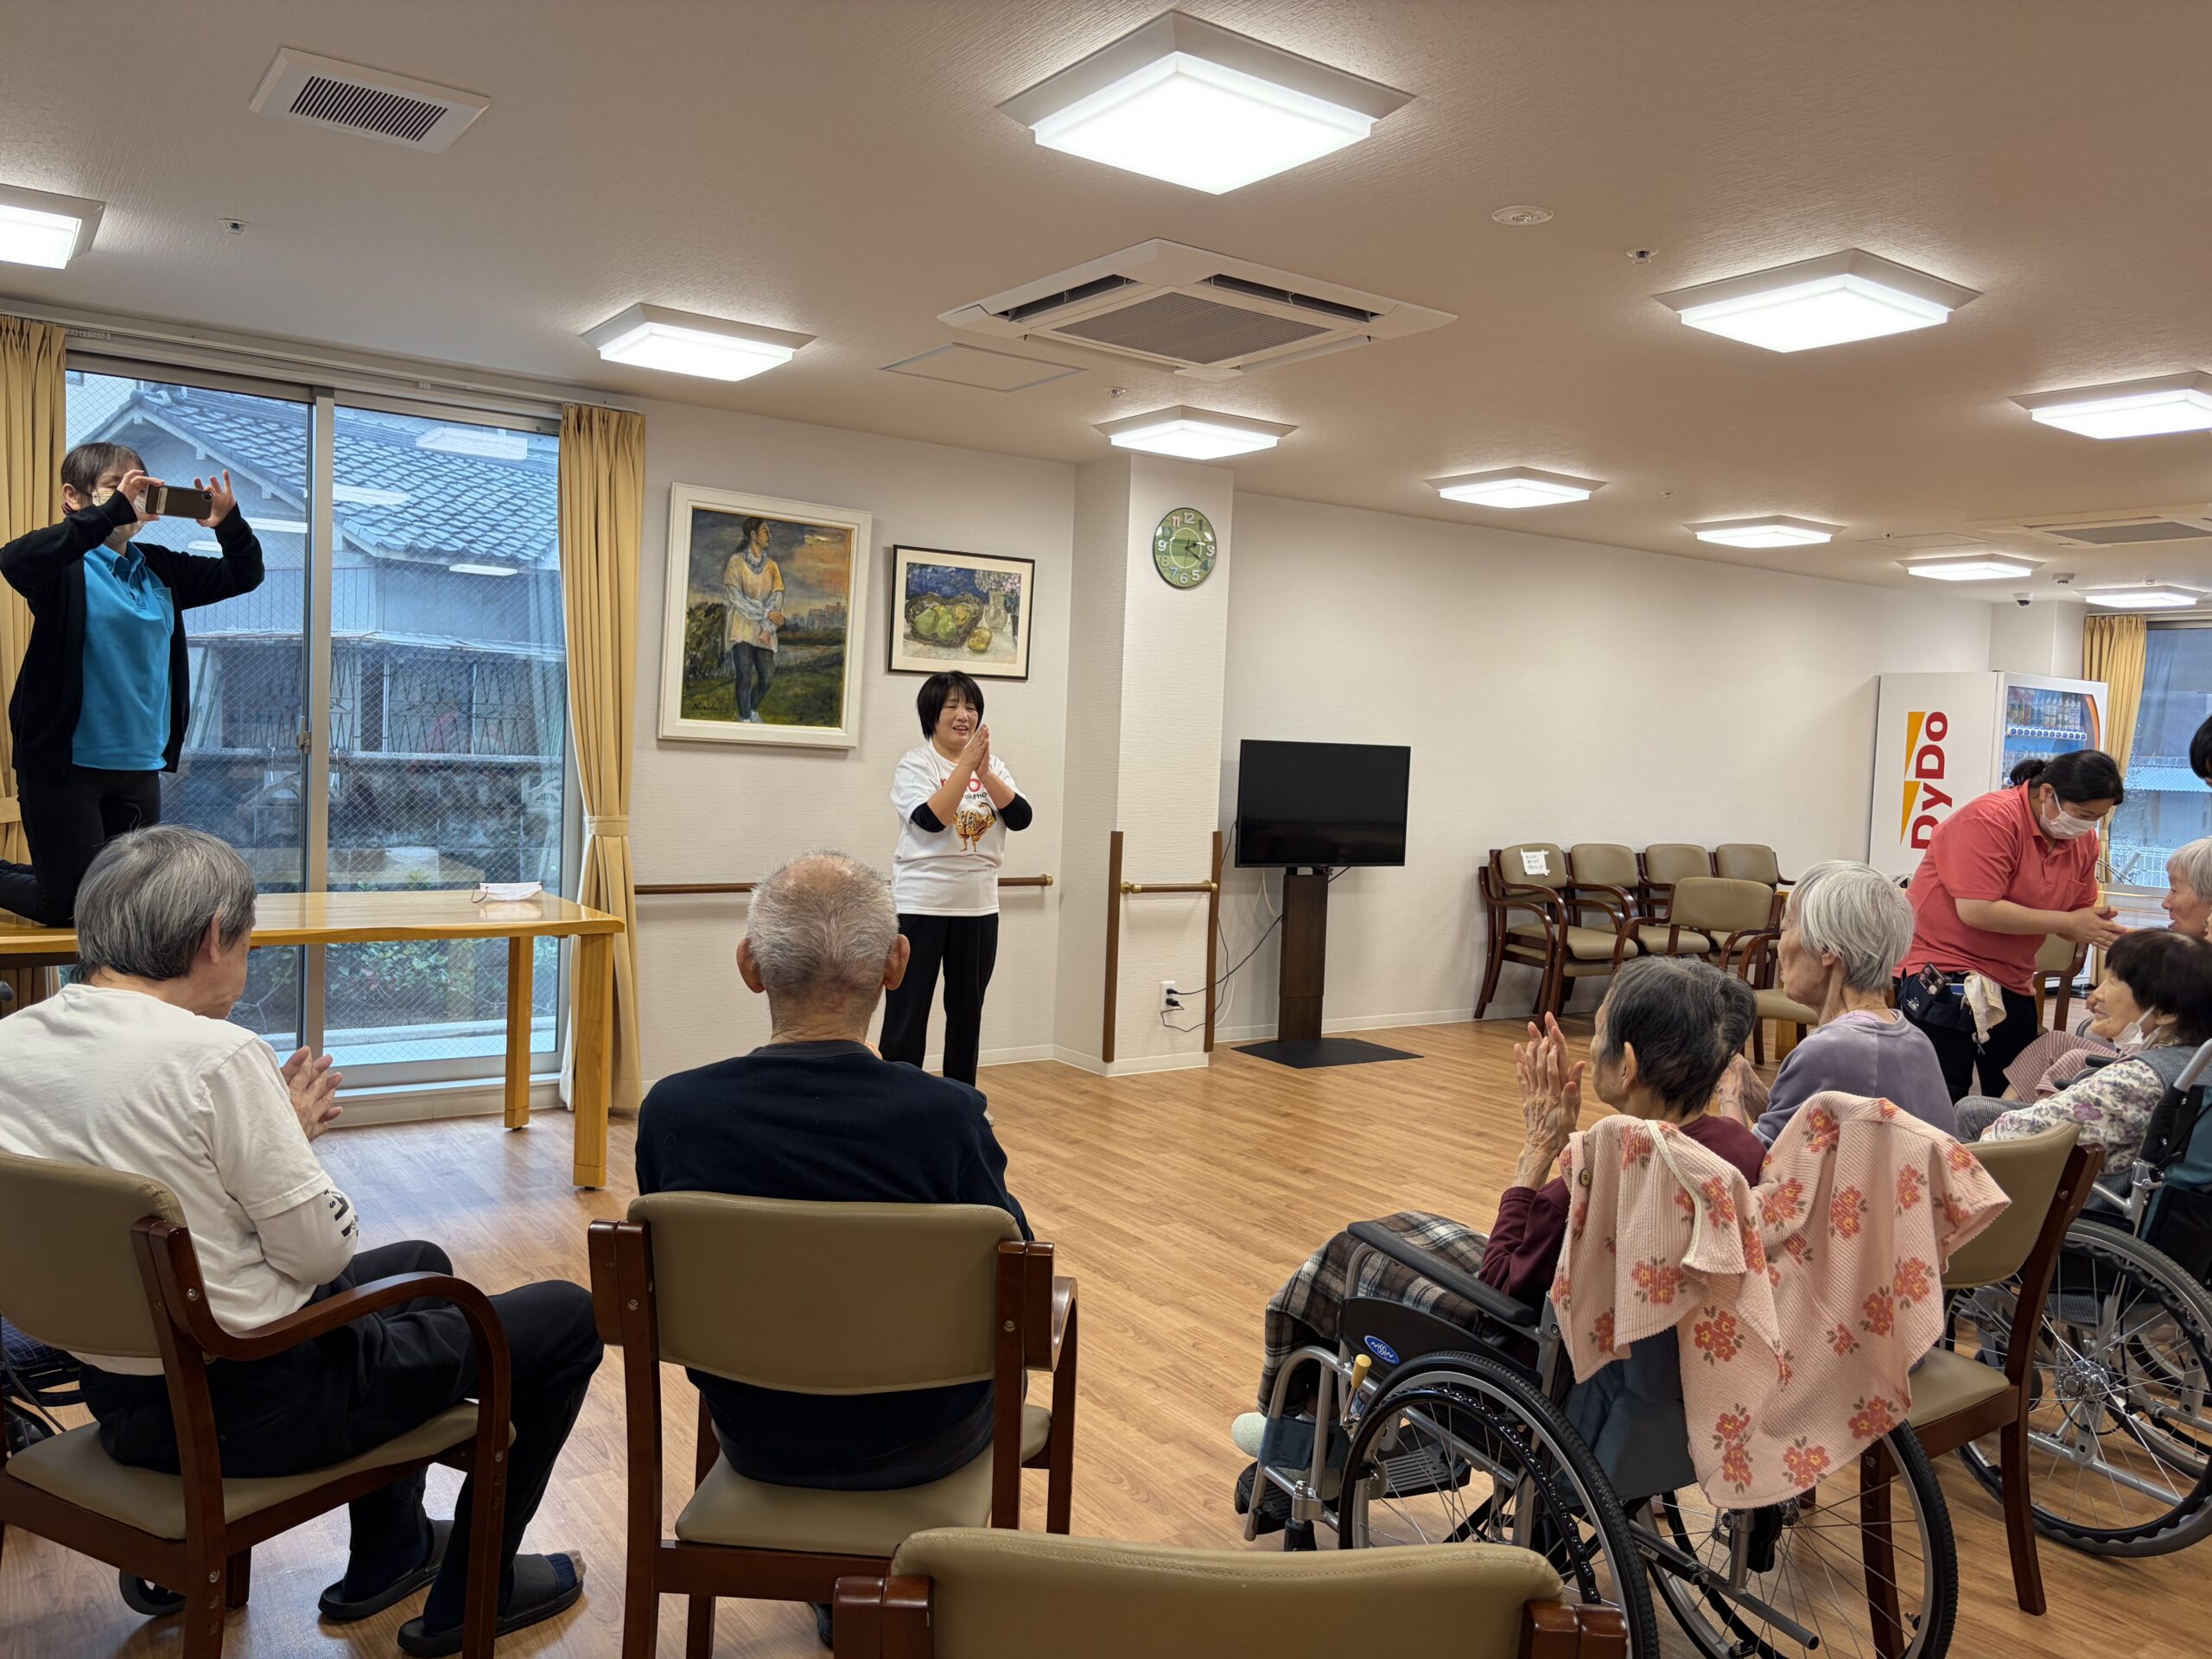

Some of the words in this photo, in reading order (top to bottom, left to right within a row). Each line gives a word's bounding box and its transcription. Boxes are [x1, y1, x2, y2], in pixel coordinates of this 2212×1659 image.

[1172, 516, 1180, 527] 11
[1184, 512, 1195, 524] 12
[1158, 539, 1166, 551] 9
[1205, 545, 1216, 556] 3
[1160, 556, 1169, 567] 8
[1169, 567, 1179, 579] 7
[1179, 573, 1188, 584] 6
[1192, 569, 1200, 581] 5
[1910, 711, 1953, 849] DyDo
